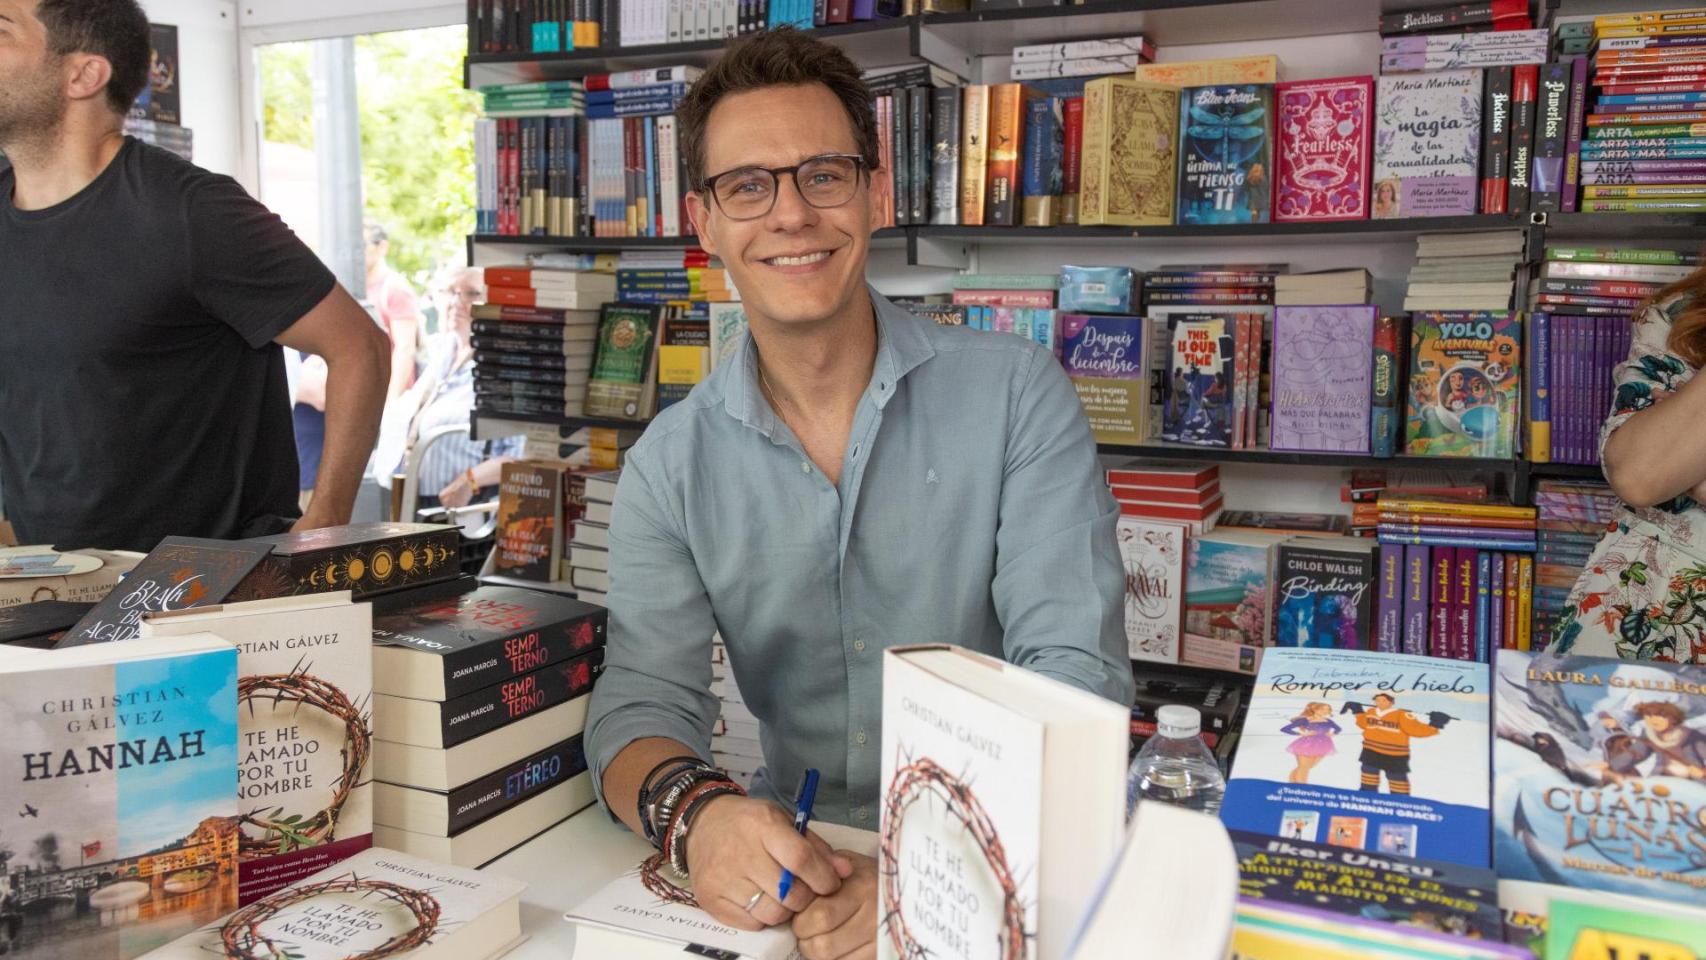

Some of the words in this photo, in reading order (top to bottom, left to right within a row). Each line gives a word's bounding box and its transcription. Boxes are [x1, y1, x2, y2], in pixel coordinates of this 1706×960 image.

[1403, 13, 1444, 29] Reckless
[1393, 81, 1423, 91] María
[1426, 78, 1471, 90] Martínez
[1195, 88, 1222, 105] Blue
[1224, 89, 1261, 105] Jeans
[1414, 107, 1429, 118] La
[1492, 92, 1509, 134] Reckless
[1545, 81, 1565, 138] Powerless
[1398, 116, 1462, 138] magia
[1596, 128, 1632, 138] ARTA
[1291, 134, 1353, 154] Fearless
[1411, 141, 1424, 154] de
[1427, 141, 1444, 151] las
[1599, 139, 1630, 148] ARTA
[1638, 138, 1667, 148] MAX
[1599, 150, 1630, 158] ARTA
[1638, 149, 1667, 158] MAX
[1188, 154, 1197, 162] LA
[1387, 154, 1467, 168] casualidades
[1511, 147, 1528, 187] Reckless
[1594, 161, 1635, 173] ARTA
[1594, 174, 1635, 184] ARTA
[1082, 326, 1135, 351] Después
[1187, 330, 1209, 340] THIS
[1440, 322, 1492, 340] YOLO
[1177, 341, 1187, 352] IS
[1190, 341, 1217, 354] OUR
[1432, 338, 1497, 353] AVENTURAS
[1070, 344, 1140, 373] diciembre
[1184, 353, 1212, 366] TIME
[1280, 408, 1298, 417] MÁS
[1301, 409, 1315, 418] QUE
[1318, 410, 1361, 419] PALABRAS
[511, 472, 543, 486] ARTURO
[1288, 560, 1323, 572] CHLOE
[1325, 562, 1363, 575] WALSH
[1125, 573, 1173, 603] RAVAL
[1281, 575, 1368, 606] Binding
[236, 639, 280, 655] STIAN
[286, 633, 340, 650] GÁLVEZ
[505, 631, 539, 659] SEMPI
[452, 665, 474, 679] JOANA
[474, 658, 498, 672] MARCÚS
[511, 647, 549, 674] TERNO
[501, 675, 536, 703] SEMPI
[1271, 674, 1371, 698] Romper
[1377, 674, 1405, 694] el
[1412, 673, 1475, 694] hielo
[1527, 669, 1603, 687] LAURA
[42, 686, 186, 715] CHRISTIAN
[507, 689, 545, 719] TERNO
[67, 709, 165, 734] GÁLVEZ
[449, 710, 470, 726] JOANA
[470, 703, 495, 719] MARCÚS
[902, 696, 953, 735] CHRISTIAN
[245, 731, 267, 747] TE
[277, 726, 300, 742] HE
[22, 729, 206, 782] HANNAH
[237, 765, 274, 783] POR
[283, 759, 308, 774] TU
[505, 754, 561, 800] ETÉREO
[457, 799, 477, 816] JOANA
[477, 788, 501, 805] MARCÚS
[1266, 793, 1282, 802] del
[1283, 795, 1325, 808] universo
[1326, 800, 1339, 809] de
[1341, 801, 1395, 816] HANNAH
[1396, 809, 1443, 823] GRACE?
[1278, 787, 1322, 799] ¿Todavía
[1323, 792, 1336, 800] no
[1338, 793, 1350, 801] te
[1352, 794, 1371, 804] has
[1372, 797, 1433, 813] enamorado
[925, 836, 940, 856] TE
[946, 853, 963, 872] HE
[1267, 841, 1334, 860] Iker
[1342, 850, 1434, 877] Unzu
[375, 860, 434, 882] CHRISTIAN
[1252, 853, 1376, 880] ATRAPADOS
[1384, 873, 1410, 886] EN
[910, 850, 980, 915] LLAMADO
[1294, 880, 1389, 903] MALDITO
[1303, 871, 1328, 881] DE
[1337, 874, 1479, 912] ATRACCIONES
[339, 903, 356, 913] TE
[360, 908, 382, 920] HE
[918, 879, 943, 910] POR
[952, 902, 969, 933] TU
[296, 917, 332, 930] POR
[338, 926, 360, 937] TU
[302, 906, 383, 932] LLAMADO
[666, 915, 739, 937] CHRISTIAN
[278, 922, 350, 947] NOMBRE
[915, 905, 972, 958] NOMBRE
